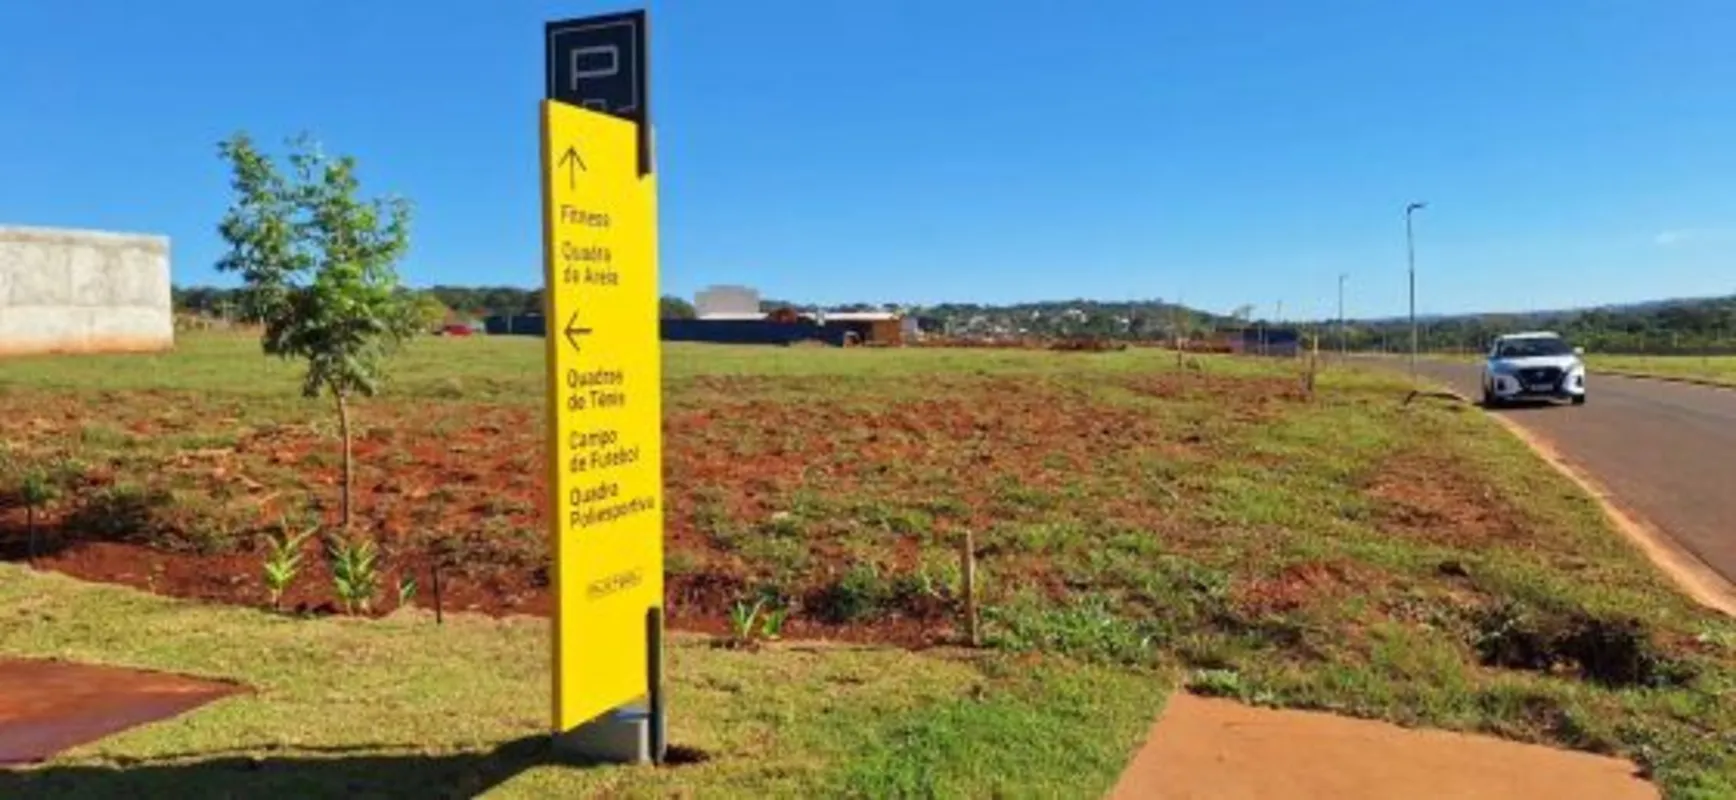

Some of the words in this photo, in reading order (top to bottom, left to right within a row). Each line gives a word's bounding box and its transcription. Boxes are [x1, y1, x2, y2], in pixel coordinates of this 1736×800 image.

[570, 45, 619, 91] P
[561, 204, 610, 229] Fitness
[561, 241, 611, 263] Quadra
[563, 266, 580, 284] de
[567, 367, 624, 388] Quadras
[567, 394, 587, 412] de
[569, 428, 618, 450] Campo
[569, 452, 587, 474] de
[591, 444, 639, 470] Futebol
[570, 480, 618, 506] Quadra
[570, 495, 655, 529] Poliesportiva
